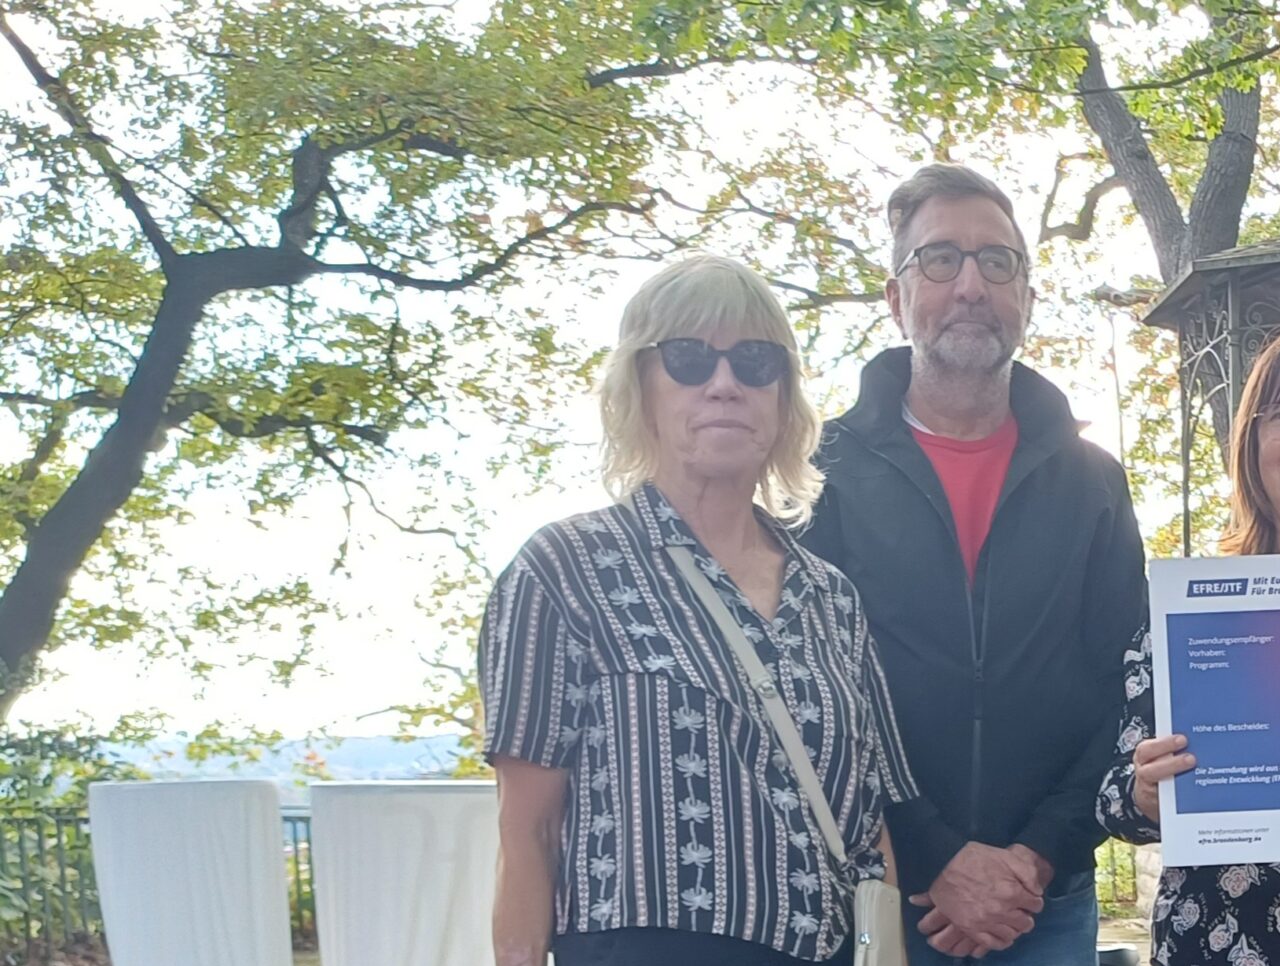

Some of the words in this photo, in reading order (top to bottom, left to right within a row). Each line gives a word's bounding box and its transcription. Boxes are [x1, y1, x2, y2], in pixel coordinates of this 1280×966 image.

[1253, 576, 1268, 585] Mit
[1192, 582, 1242, 594] EFRE/JTF
[1251, 586, 1266, 595] Für
[1188, 649, 1226, 657] Vorhaben:
[1189, 661, 1229, 671] Programm:
[1192, 724, 1212, 733] Höhe
[1213, 724, 1226, 732] des
[1228, 723, 1270, 731] Bescheides:
[1194, 767, 1206, 775] Die
[1208, 766, 1247, 775] Zuwendung
[1249, 765, 1265, 773] wird
[1195, 776, 1228, 787] regionale
[1229, 775, 1270, 785] Entwicklung
